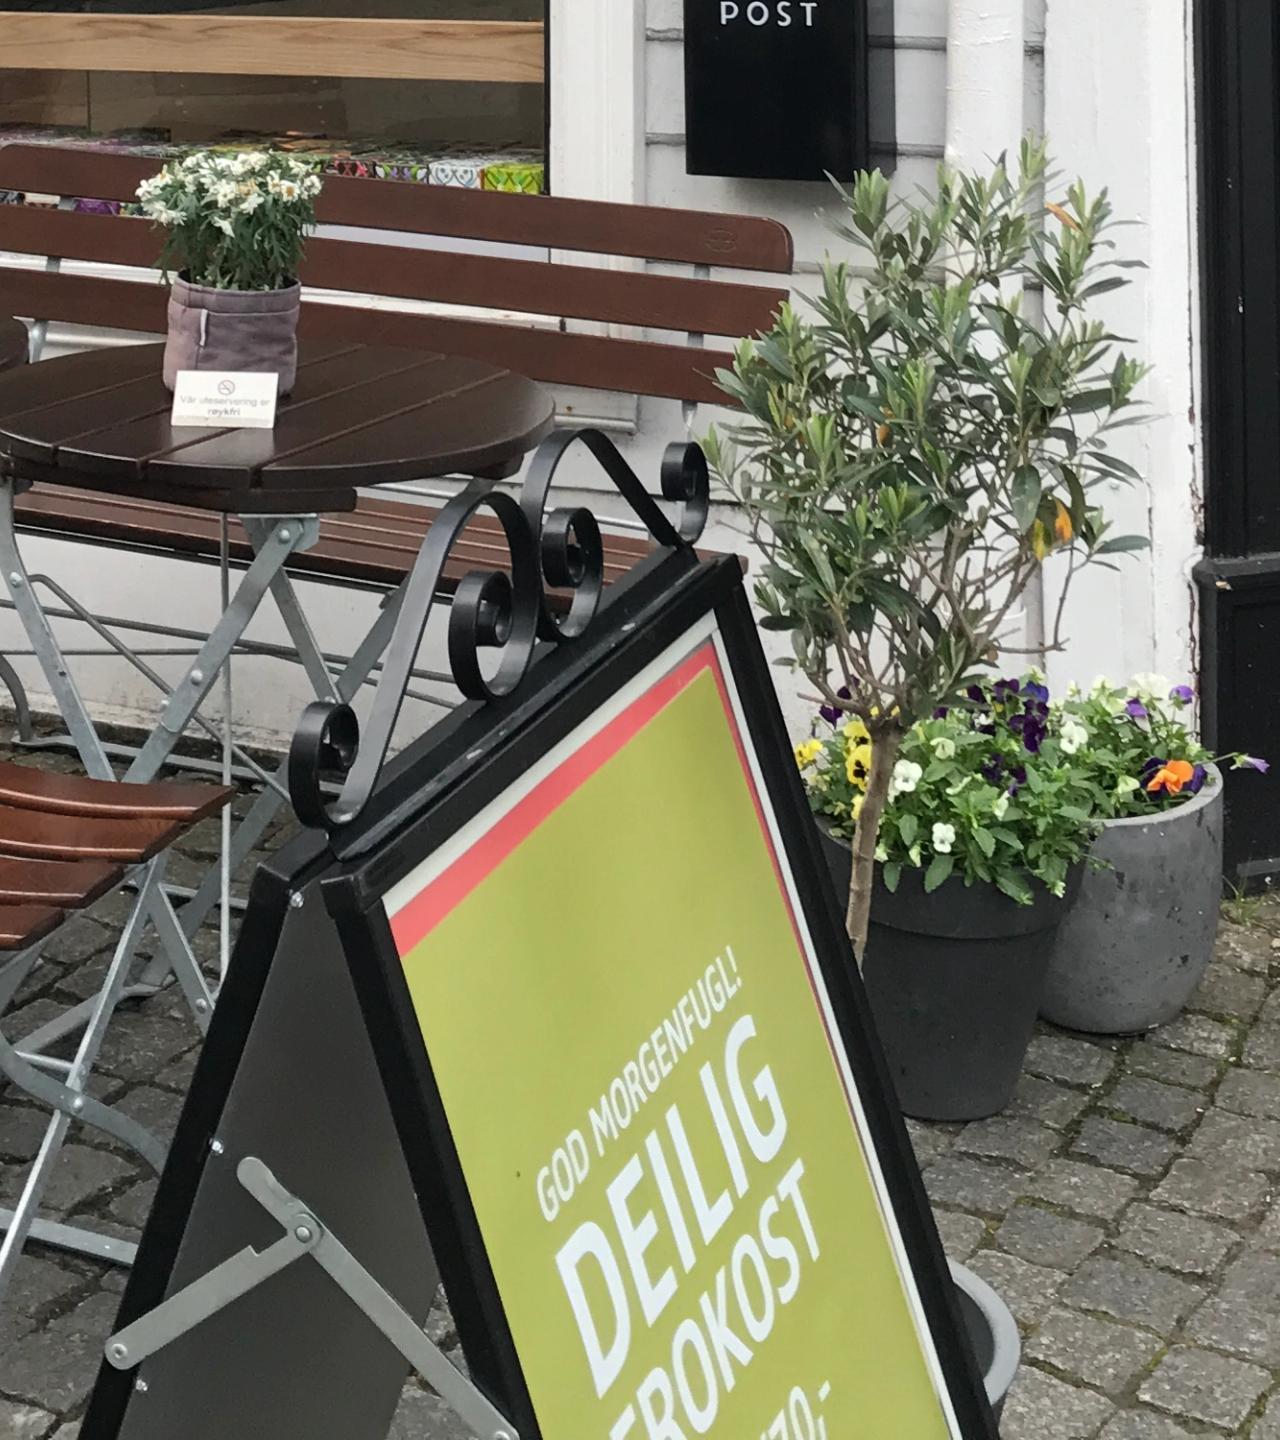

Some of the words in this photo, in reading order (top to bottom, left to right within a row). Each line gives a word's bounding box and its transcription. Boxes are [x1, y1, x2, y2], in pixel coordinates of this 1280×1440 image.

[720, 1, 818, 27] POST
[208, 407, 240, 417] røykfri
[536, 1129, 590, 1223] GOD
[587, 944, 743, 1157] MORGENFUGL!
[554, 1014, 788, 1399] DEILIG
